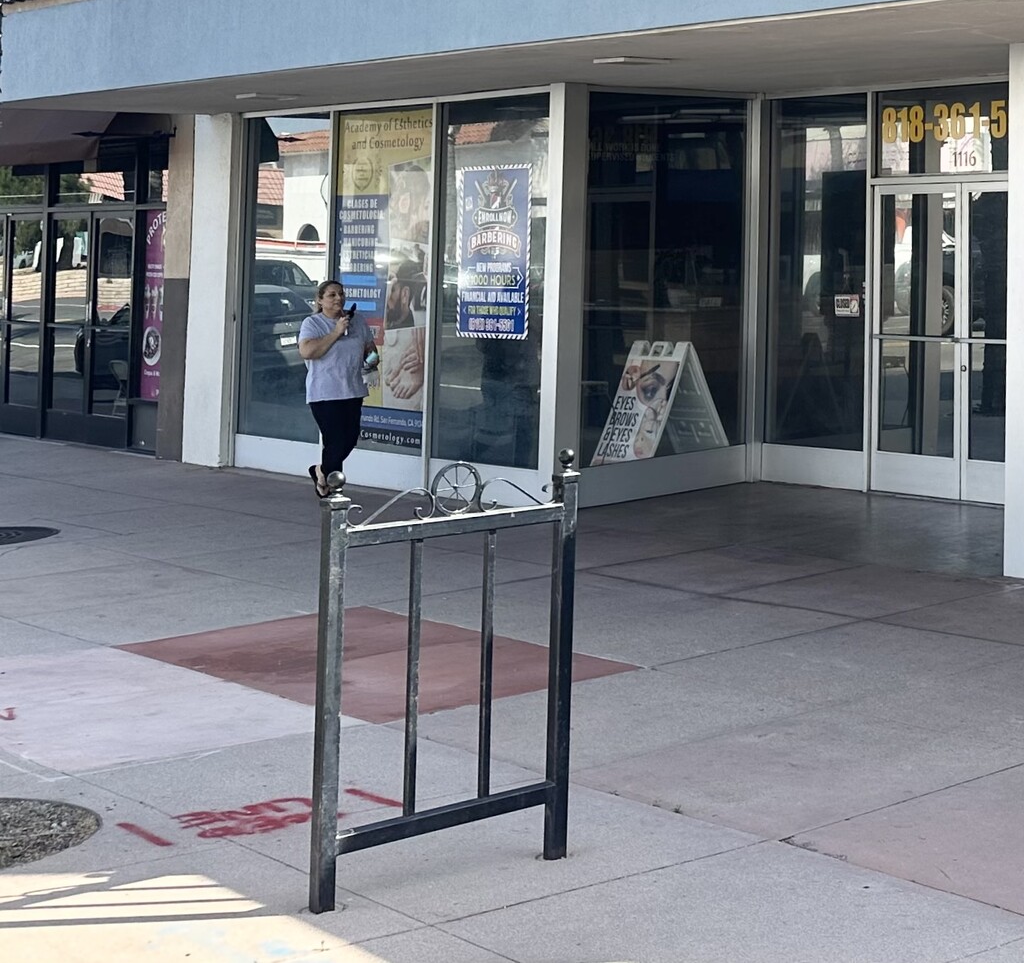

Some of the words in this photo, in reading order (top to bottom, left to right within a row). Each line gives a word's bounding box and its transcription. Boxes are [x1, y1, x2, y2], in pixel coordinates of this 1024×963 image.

[344, 119, 382, 136] Academy
[383, 117, 393, 131] of
[394, 116, 433, 131] Esthetics
[351, 137, 367, 150] and
[369, 134, 425, 152] Cosmetology
[952, 150, 977, 167] 1116
[369, 198, 378, 209] DE
[471, 231, 518, 248] BARBERING
[491, 274, 516, 286] HOURS
[461, 291, 487, 303] FINANCIAL
[487, 291, 497, 303] AID
[497, 291, 525, 304] AVAILABLE
[614, 395, 636, 411] EYES
[609, 411, 639, 427] BROWS
[611, 427, 633, 443] EYES
[597, 442, 630, 459] LASHES
